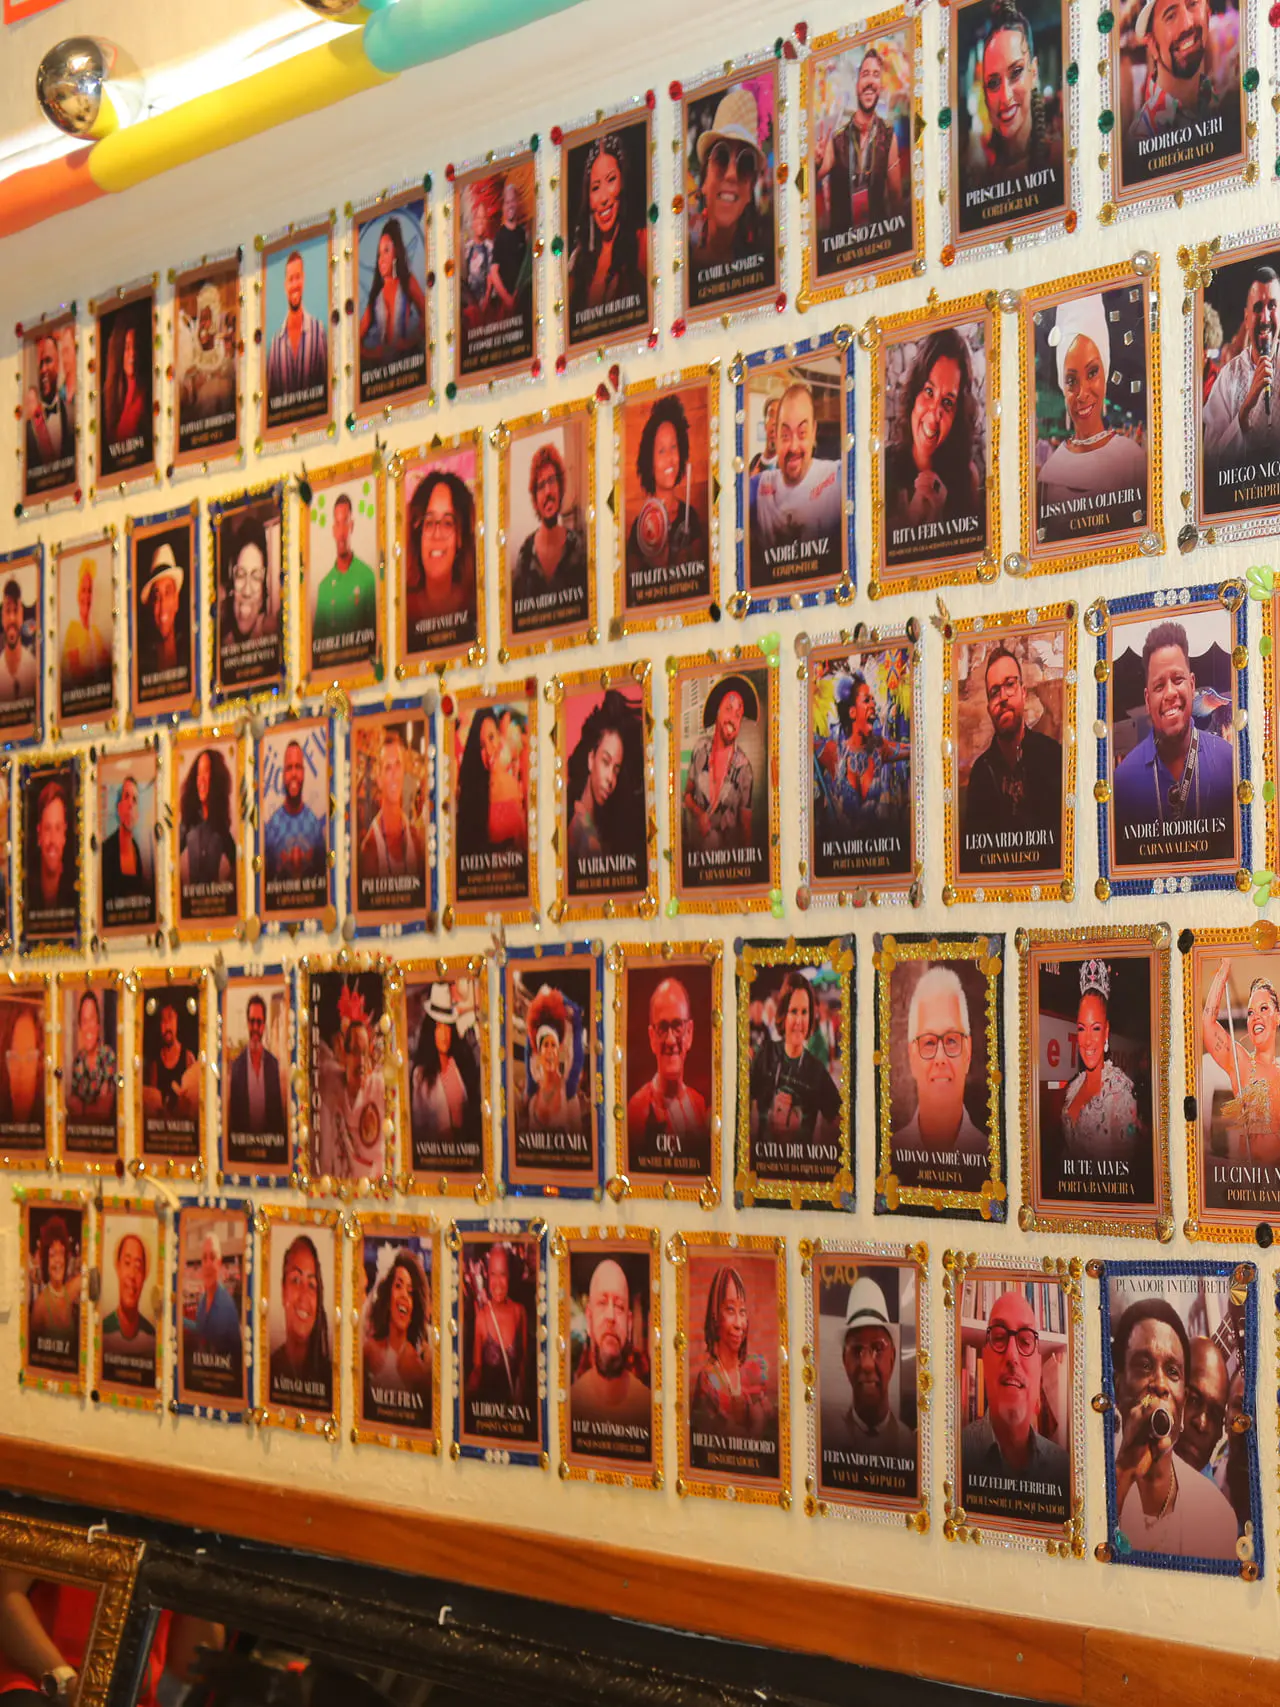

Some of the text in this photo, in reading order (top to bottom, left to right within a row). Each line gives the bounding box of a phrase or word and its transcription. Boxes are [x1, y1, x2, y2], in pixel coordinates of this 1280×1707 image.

[1138, 118, 1224, 156] RODRIGO NERI
[1147, 142, 1215, 171] COREÓGRAFO
[965, 168, 1057, 207] PRISCILLA MOTA
[1217, 464, 1256, 486] DIEGO
[1039, 488, 1142, 519] LISSANDRA OLIVEIRA
[892, 516, 979, 544] RITA FERNANDES
[1069, 514, 1111, 530] CANTORA
[763, 538, 830, 564] ANDRÉ DINIZ
[1123, 818, 1226, 840] ANDRÉ RODRIGUES
[822, 837, 901, 856] DENADIR GARCIA
[965, 830, 1055, 850] LEONARDO BORA
[1138, 840, 1209, 856] CARNAVALESCO
[577, 854, 637, 875] MARKINHOS
[687, 848, 763, 868] LEANDRO VIEIRA
[655, 1134, 683, 1156] CIÇA
[785, 1143, 839, 1160] DRUMOND
[930, 1149, 961, 1166] ANDRÉ
[961, 1153, 989, 1167] MOTA
[1063, 1160, 1130, 1176] RUTE ALVES
[1213, 1166, 1271, 1185] LUCINHA
[1226, 1189, 1257, 1201] PORTA
[1116, 1280, 1164, 1292] PUXADOR
[692, 1432, 776, 1454] HELENA THEODORO
[823, 1450, 915, 1471] FERNANDO PENTEADO
[967, 1474, 1063, 1496] LUIZ FELIPE FERREIRA
